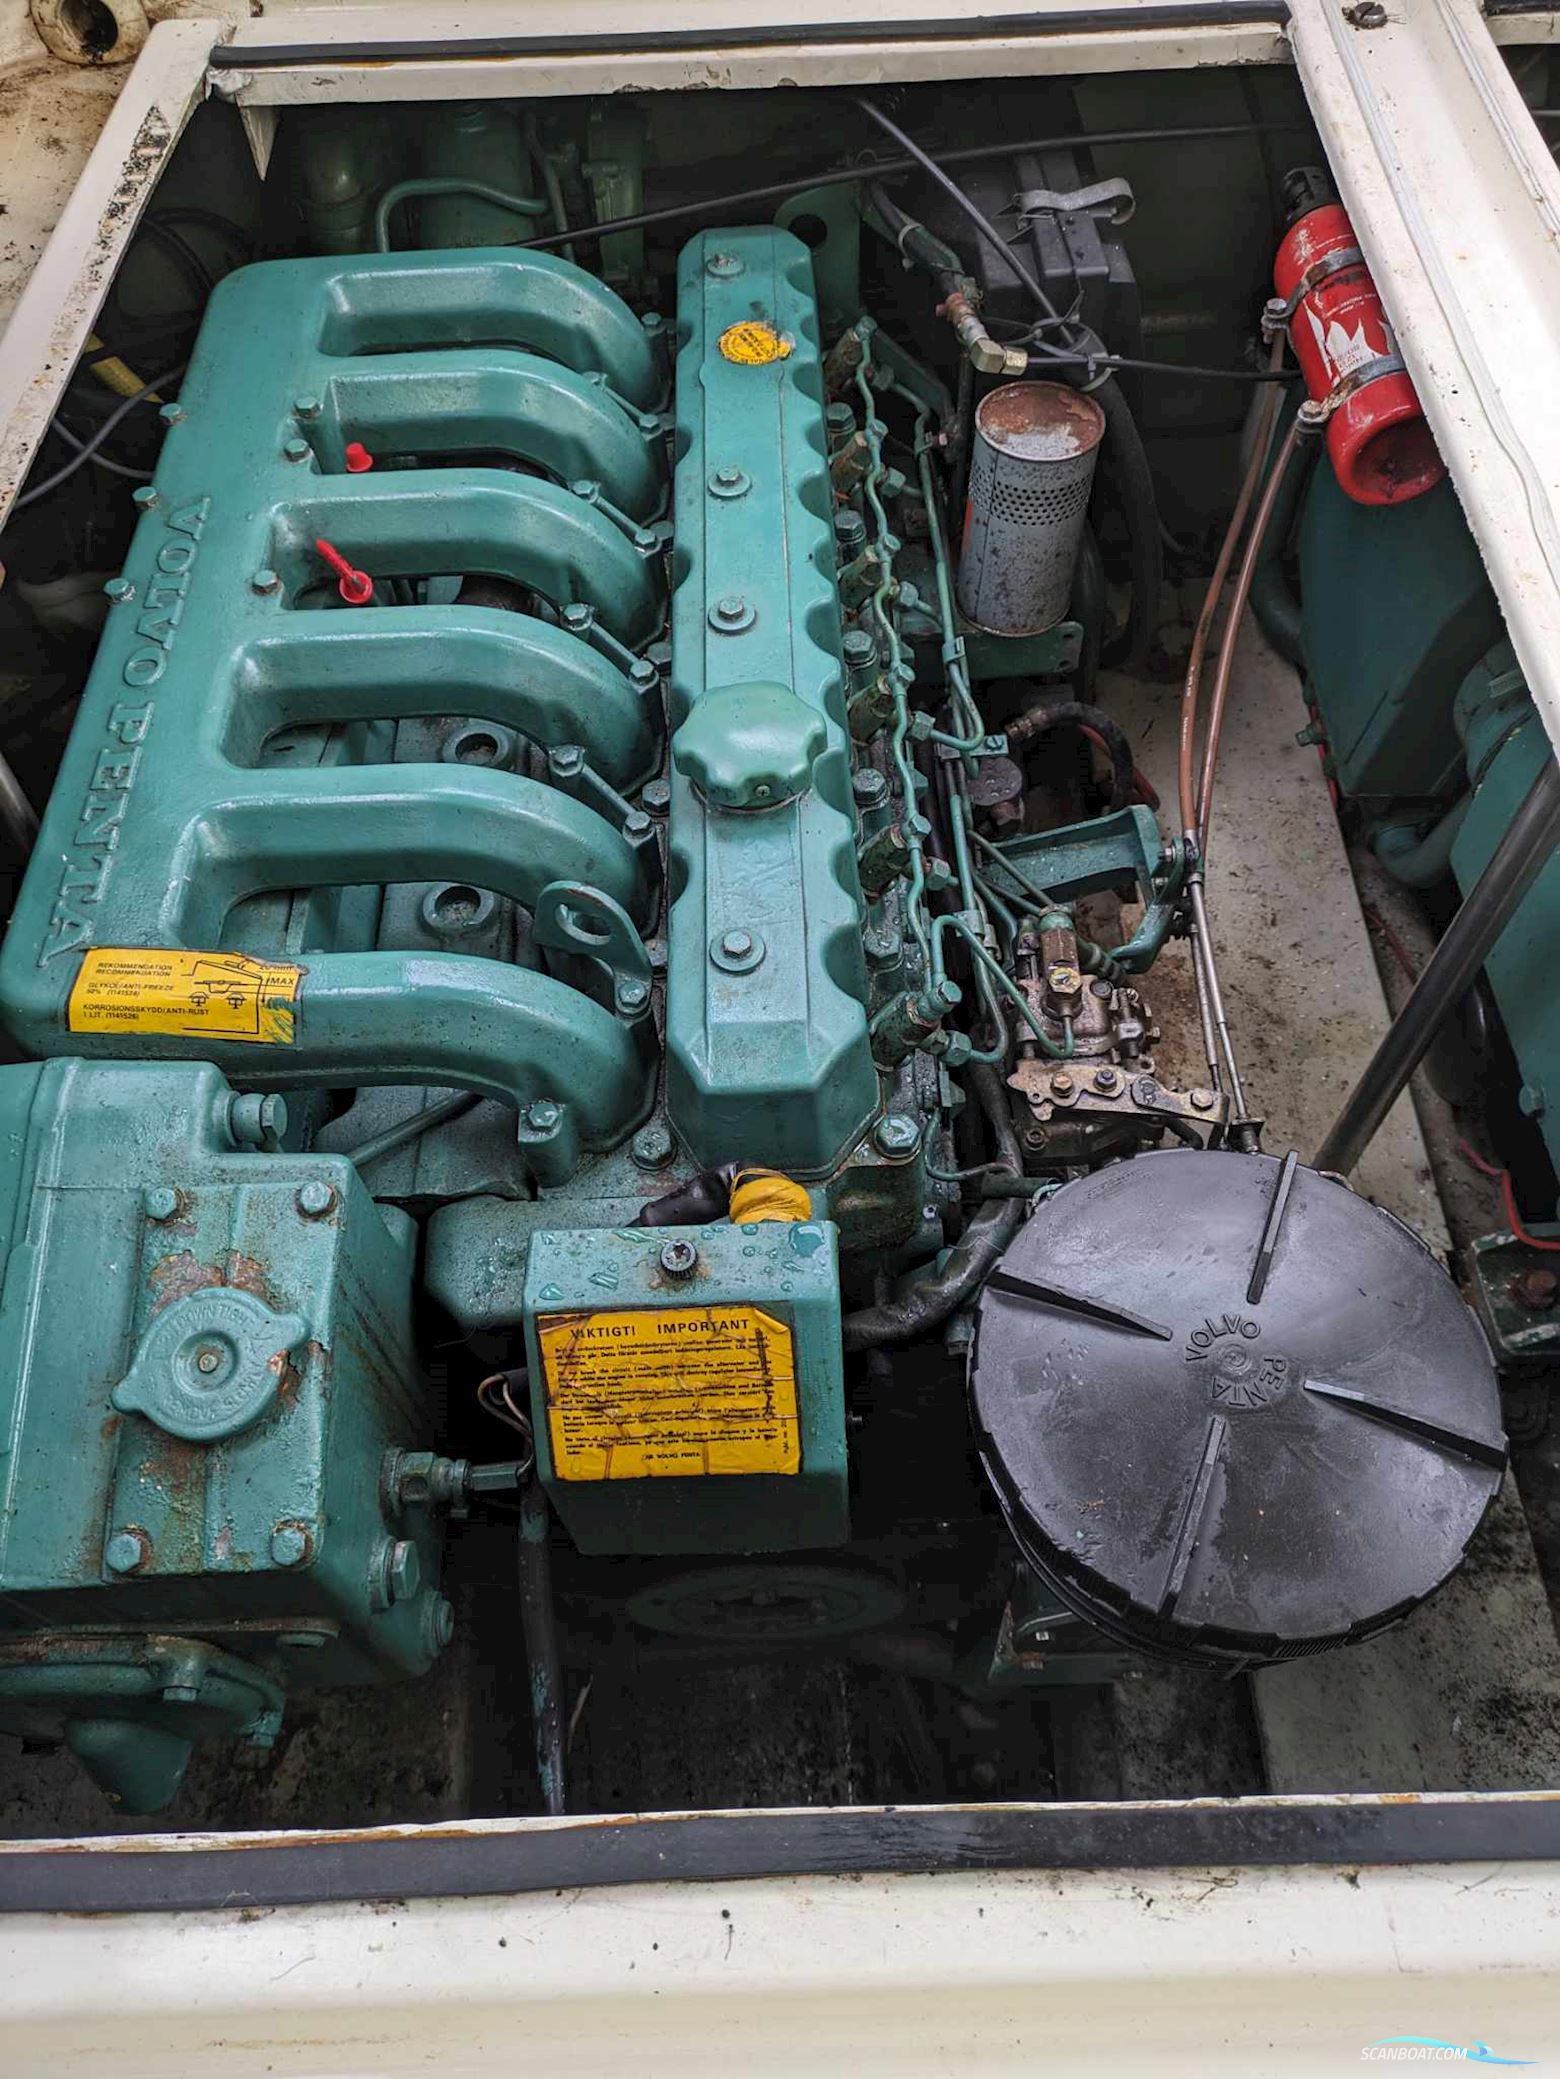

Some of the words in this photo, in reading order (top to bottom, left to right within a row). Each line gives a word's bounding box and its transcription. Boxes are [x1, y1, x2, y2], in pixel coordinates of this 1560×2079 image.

[125, 496, 211, 687] VOLVO
[36, 700, 154, 968] PENTA
[270, 977, 295, 985] MAX
[657, 1319, 750, 1334] IMPORTANT
[1185, 1314, 1261, 1362] VOLVO
[1211, 1355, 1288, 1407] PENTA
